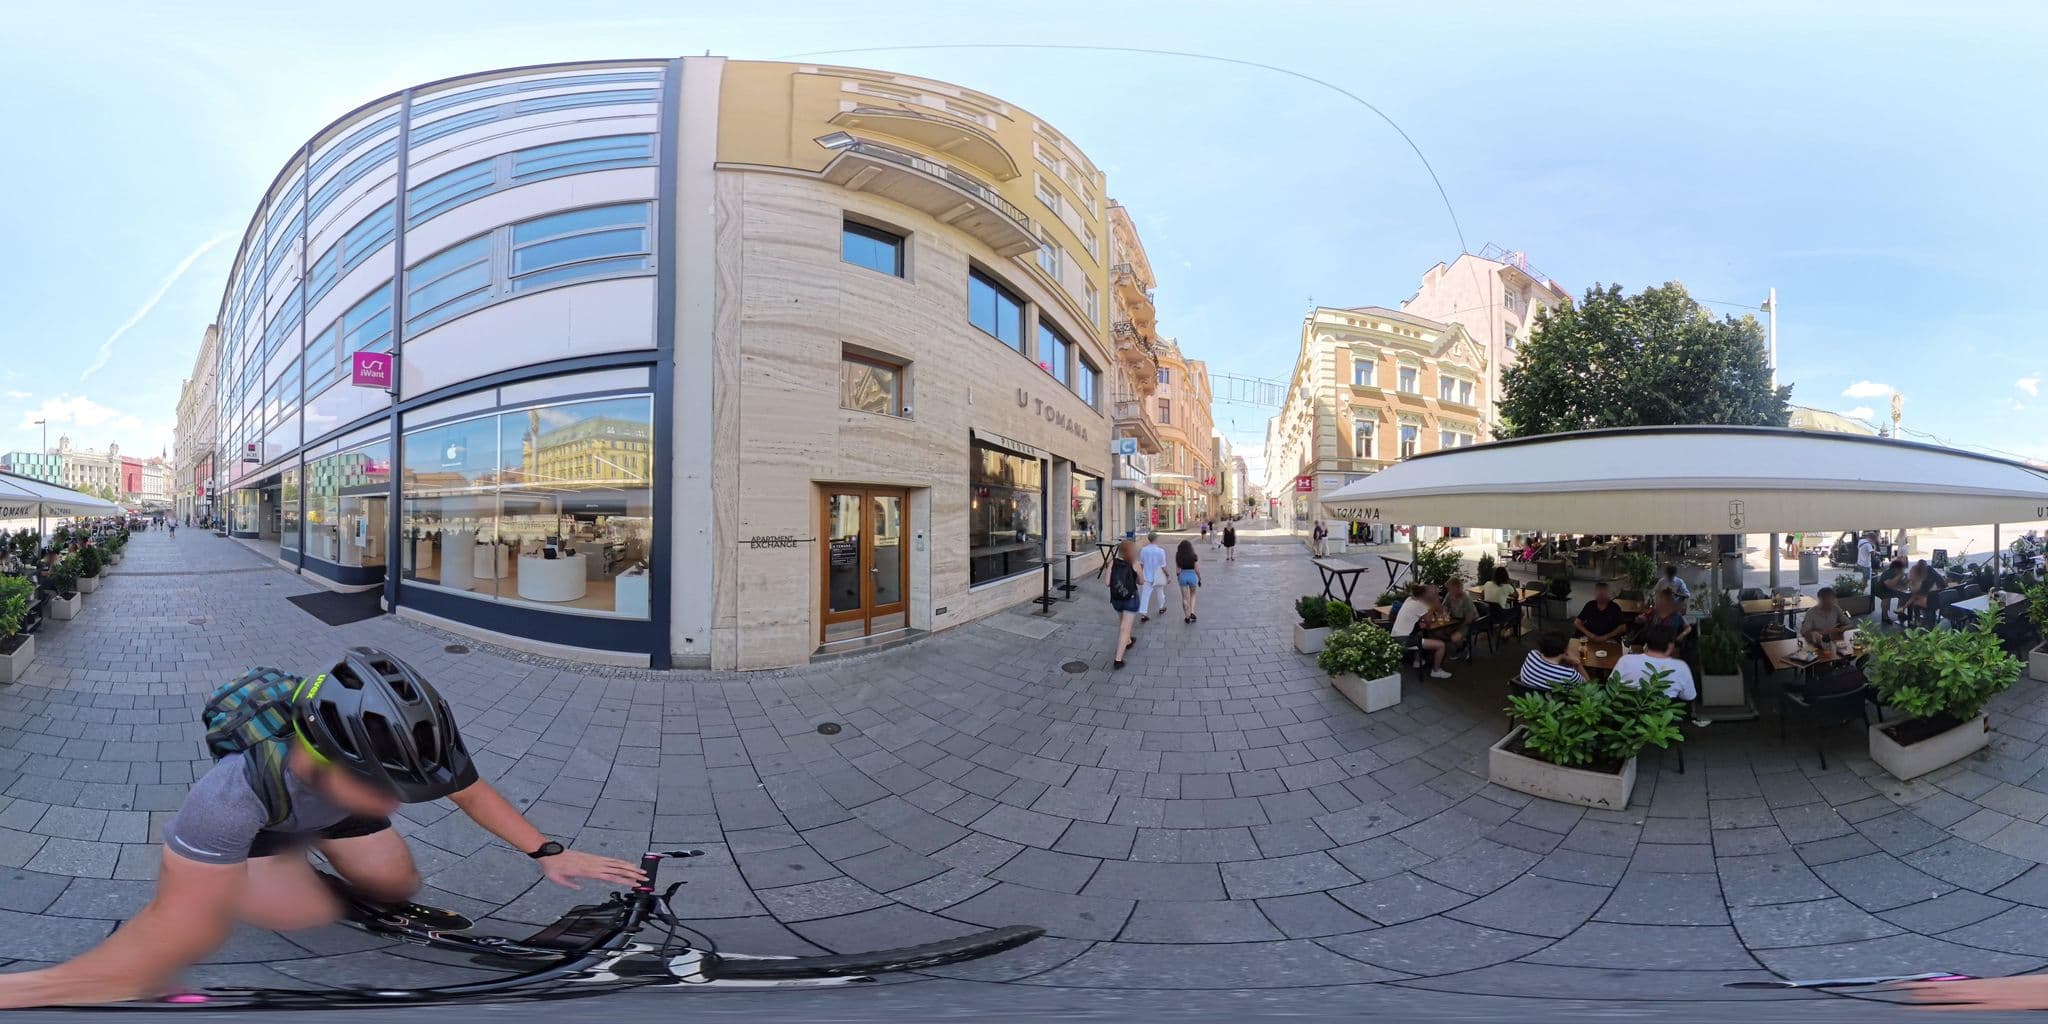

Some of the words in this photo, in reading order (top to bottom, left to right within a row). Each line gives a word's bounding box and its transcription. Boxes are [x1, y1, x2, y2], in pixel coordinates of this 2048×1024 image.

[360, 369, 385, 379] iWant
[1017, 387, 1028, 408] U
[1034, 397, 1088, 442] TOMANA
[1337, 508, 1380, 520] TOMANA
[2037, 506, 2044, 518] U
[750, 540, 798, 549] EXCHANGE
[751, 535, 794, 543] APARTMENT
[306, 674, 326, 699] uvex
